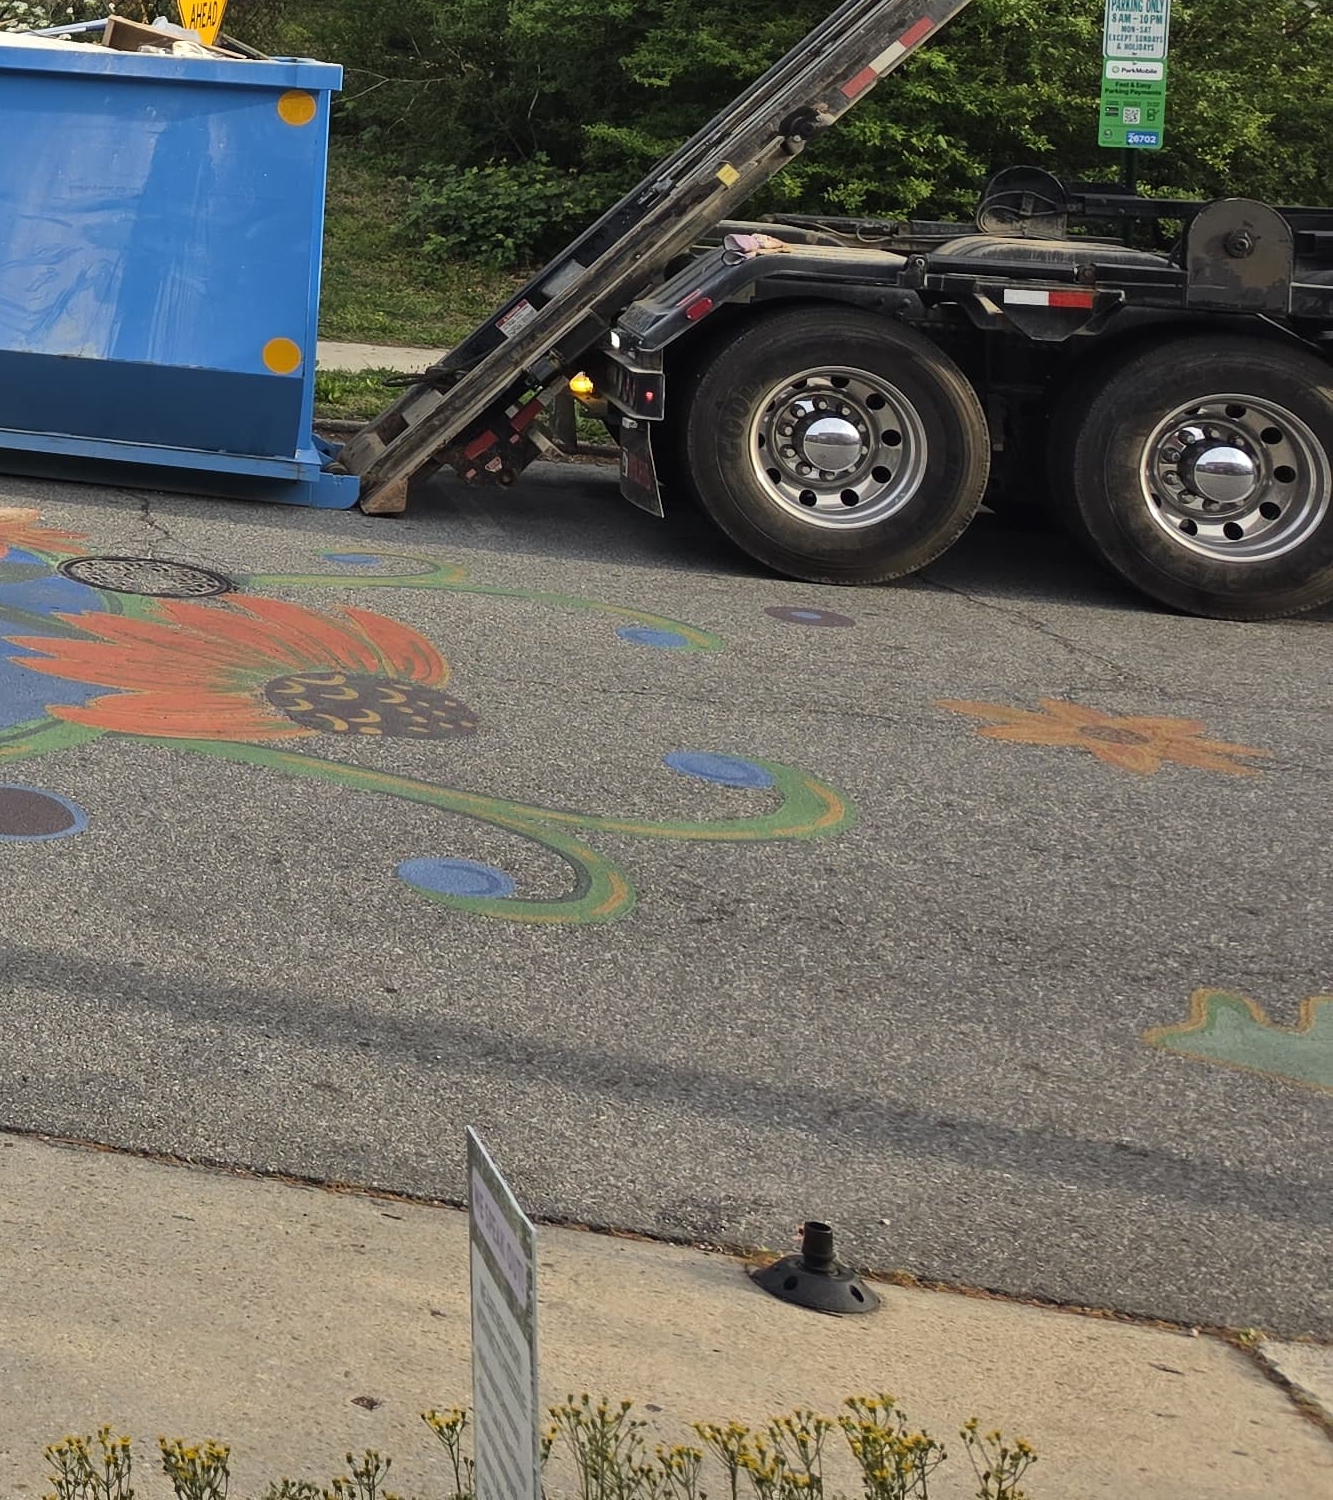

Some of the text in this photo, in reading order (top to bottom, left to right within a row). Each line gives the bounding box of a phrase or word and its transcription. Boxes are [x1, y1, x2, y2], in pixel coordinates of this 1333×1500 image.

[189, 1, 218, 30] AHEAD
[1109, 34, 1163, 44] EXCEPT SUNDAYS
[1125, 43, 1155, 51] HOLIDAYS
[1136, 82, 1152, 90] Easy
[1105, 88, 1162, 96] Parking Payments
